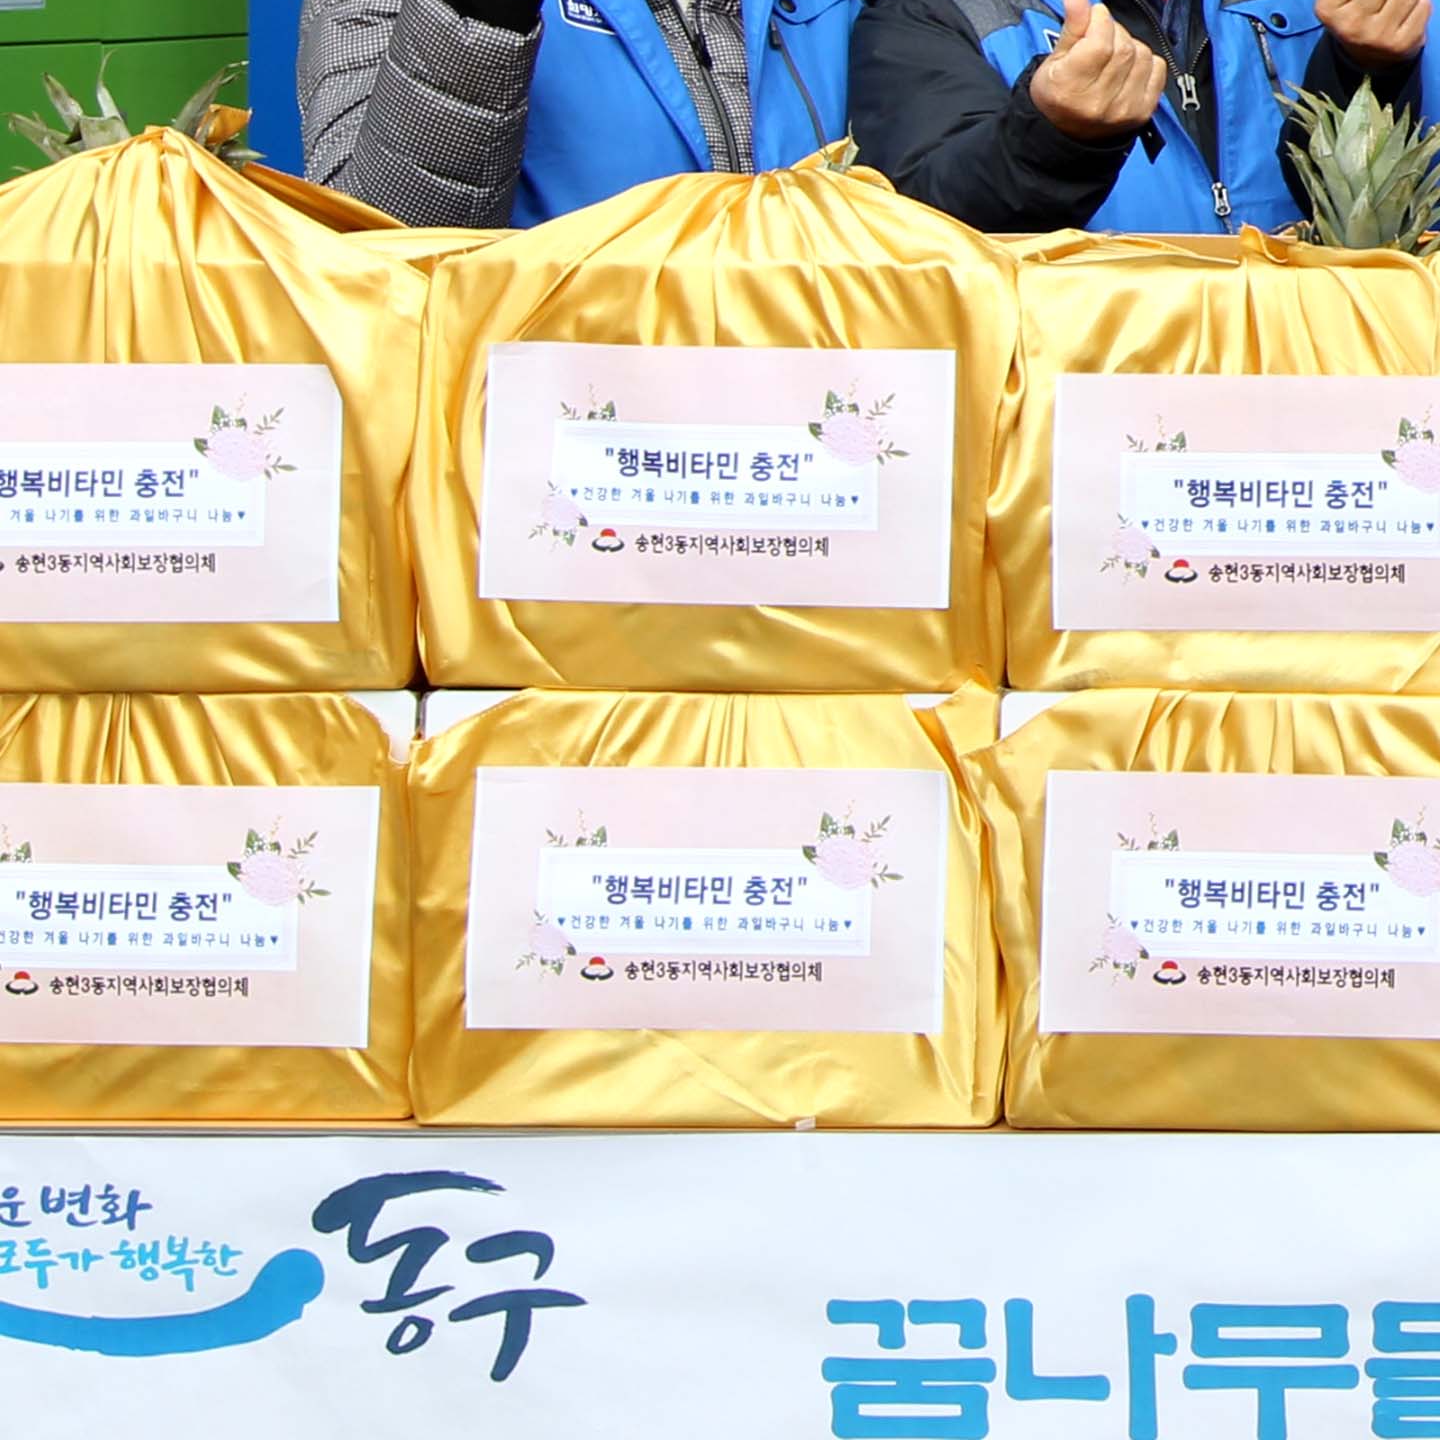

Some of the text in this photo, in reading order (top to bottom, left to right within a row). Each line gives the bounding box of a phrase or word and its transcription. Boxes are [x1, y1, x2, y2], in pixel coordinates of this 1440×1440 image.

[605, 447, 813, 482] "행복비타민 충전"
[134, 469, 200, 498] 충전"
[1174, 479, 1387, 509] "행복비타민 충전"
[584, 487, 846, 507] 건강한 겨울 나기를 위한 과일바구니 나눔
[10, 509, 232, 523] 겨울 나기를 위한 과일바구니 나눔
[1154, 518, 1421, 535] 건강한 겨울 나기를 위한 과일바구니 나눔
[635, 533, 829, 557] 송현3동지역사회보장협의체
[15, 553, 216, 574] 송현3동지역사회보장협의체
[1209, 563, 1405, 584] 송현3동지역사회보장협의체
[592, 874, 807, 906] "행복비타민 충전"
[1165, 878, 1380, 911] "행복비타민 충전"
[16, 890, 232, 922] "행복비타민 충전"
[44, 930, 68, 945] 겨울
[79, 931, 117, 945] 나기를
[128, 931, 152, 946] 위한
[163, 932, 230, 946] 과일바구니
[240, 933, 265, 947] 나눔
[625, 960, 823, 982] 송현3동지역사회보장협의체
[1197, 965, 1395, 988] 송현3동지역사회보장협의체
[50, 976, 249, 997] 송현3동지역사회보장협의체
[40, 1183, 153, 1230] 변화
[110, 1235, 244, 1292] 행복한
[312, 1170, 588, 1382] 동구
